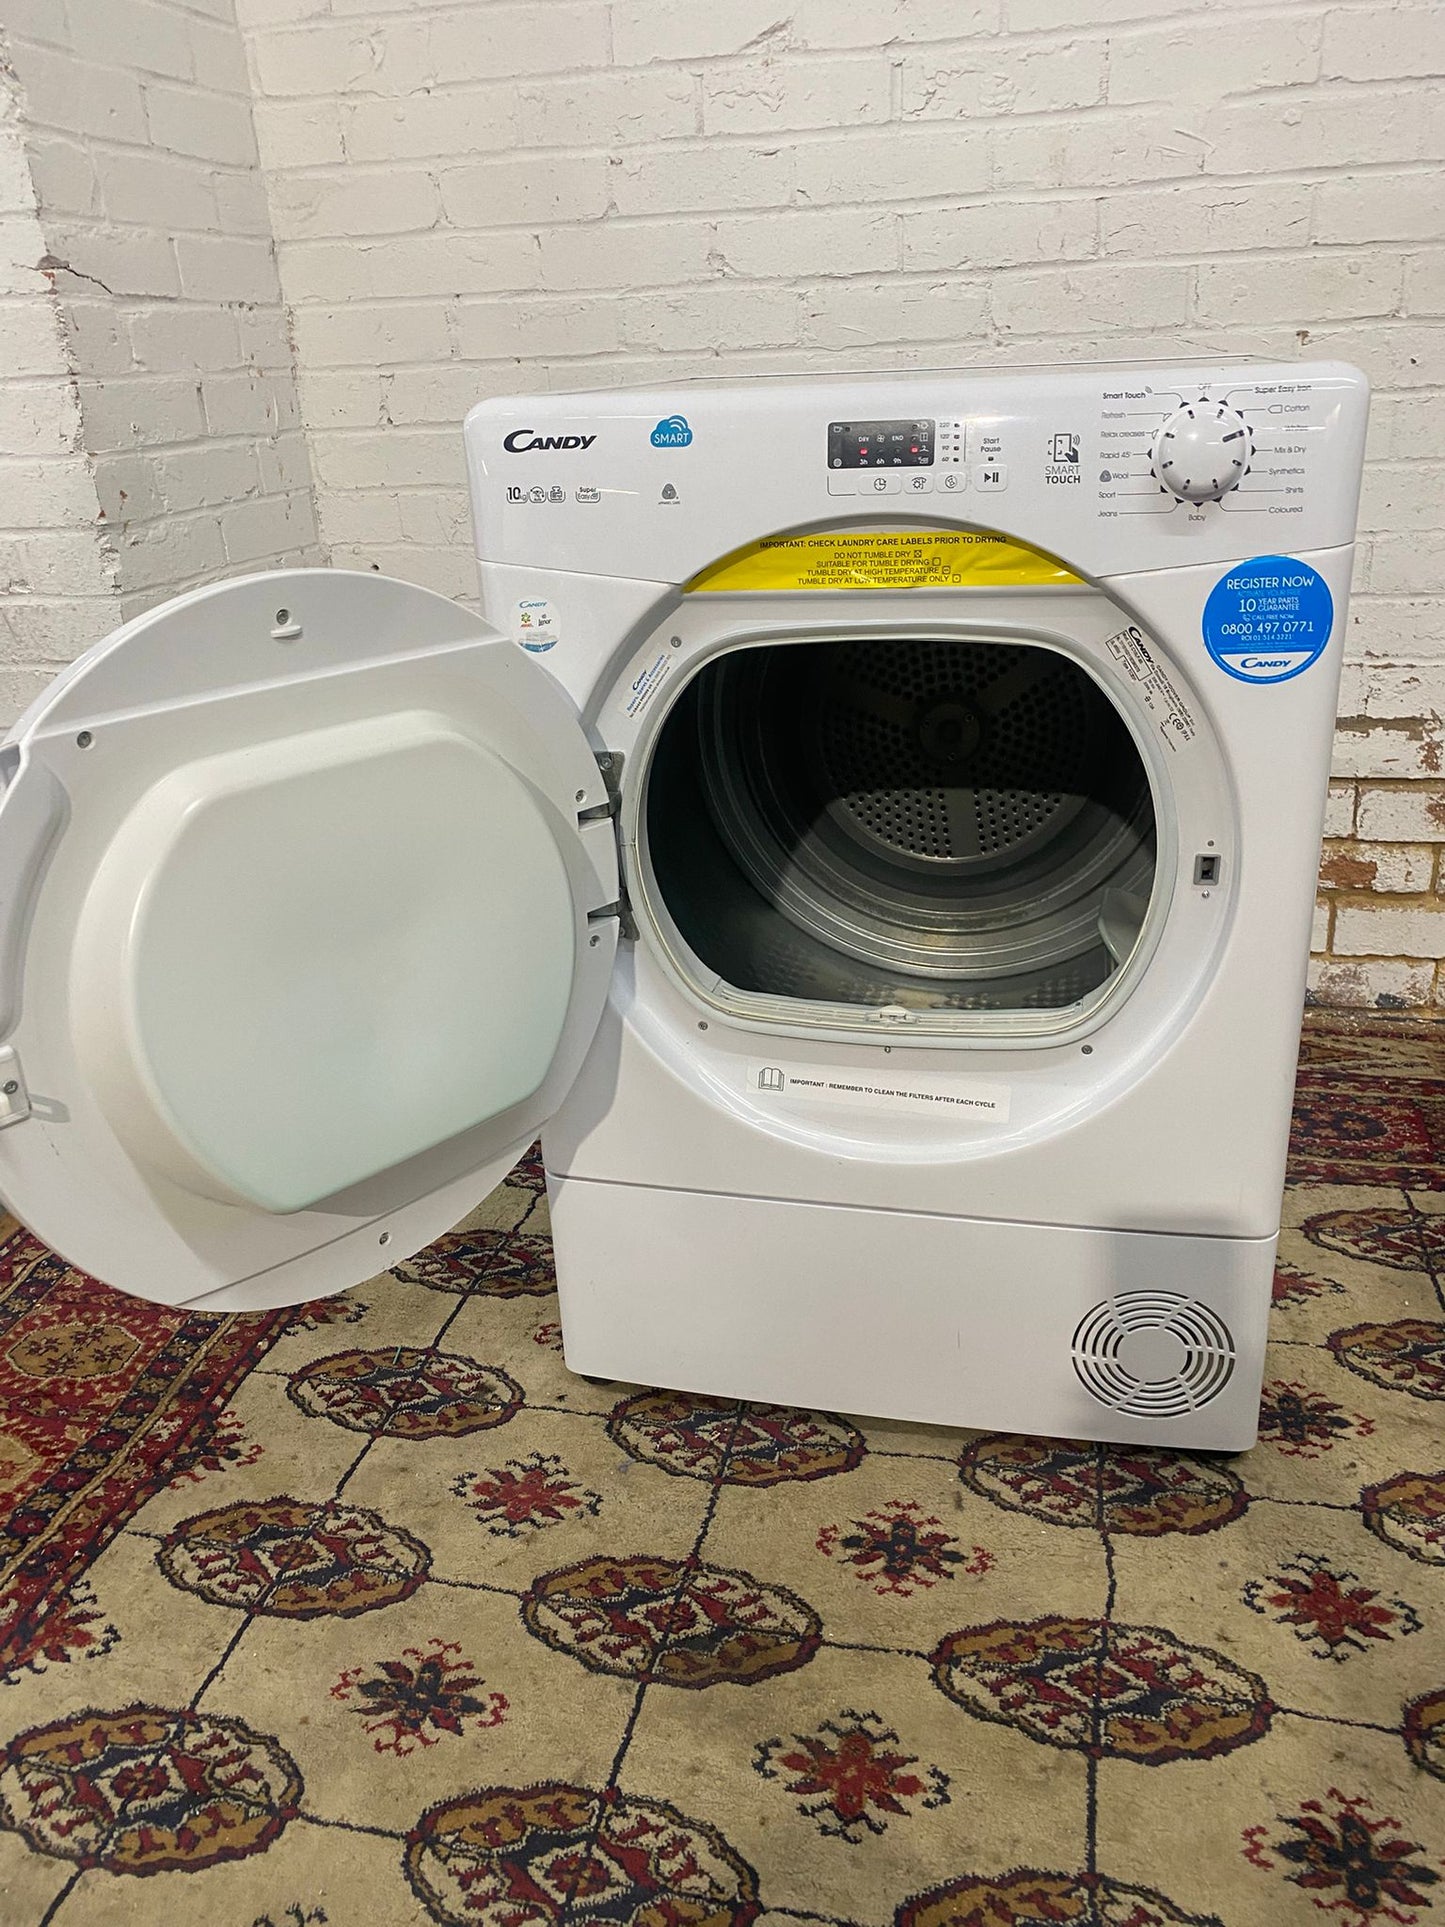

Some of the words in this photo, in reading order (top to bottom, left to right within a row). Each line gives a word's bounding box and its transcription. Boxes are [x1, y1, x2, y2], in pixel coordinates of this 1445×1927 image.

[1254, 386, 1276, 394] Super
[1125, 391, 1146, 399] Touch
[1284, 404, 1310, 413] Cotton
[654, 433, 689, 445] SMART
[1294, 446, 1307, 455] Dry
[1045, 465, 1080, 475] SMART
[1268, 467, 1305, 477] Synthetics
[1045, 475, 1080, 484] TOUCH
[1285, 486, 1304, 494] Shirts
[1098, 491, 1116, 499] Sport
[1097, 510, 1118, 518] Jeans
[1268, 505, 1304, 514] Coloured
[1188, 514, 1207, 522] Baby
[837, 539, 874, 547] LAUNDRY
[876, 538, 898, 546] CARE
[901, 537, 932, 545] LABELS
[934, 536, 960, 544] PRIOR
[847, 551, 862, 559] NOT
[816, 560, 850, 568] SUITABLE
[869, 559, 899, 567] TUMBLE
[900, 558, 930, 566] DRYING
[837, 568, 852, 576] DRY
[885, 566, 939, 575] TEMPERATURE
[798, 577, 826, 585] TUMBLE
[828, 577, 843, 585] DRY
[873, 575, 927, 584] TEMPERATURE
[929, 575, 949, 583] ONLY
[1226, 577, 1279, 590] REGISTER
[1282, 575, 1315, 587] NOW
[1238, 598, 1256, 612] 10
[1258, 597, 1277, 605] YEAR
[1278, 596, 1299, 604] PARTS
[1257, 603, 1300, 611] GUARANTEE
[1221, 623, 1253, 635] 0800
[1257, 622, 1280, 634] 497
[1282, 621, 1314, 633] 0771
[790, 1078, 825, 1087] IMPORTANT
[829, 1083, 864, 1092] REMEMBER
[874, 1088, 894, 1096] CLEAN
[909, 1093, 934, 1101] FILTERS
[934, 1095, 955, 1104] AFTER
[956, 1098, 974, 1106] EACH
[974, 1100, 996, 1108] CYCLE
